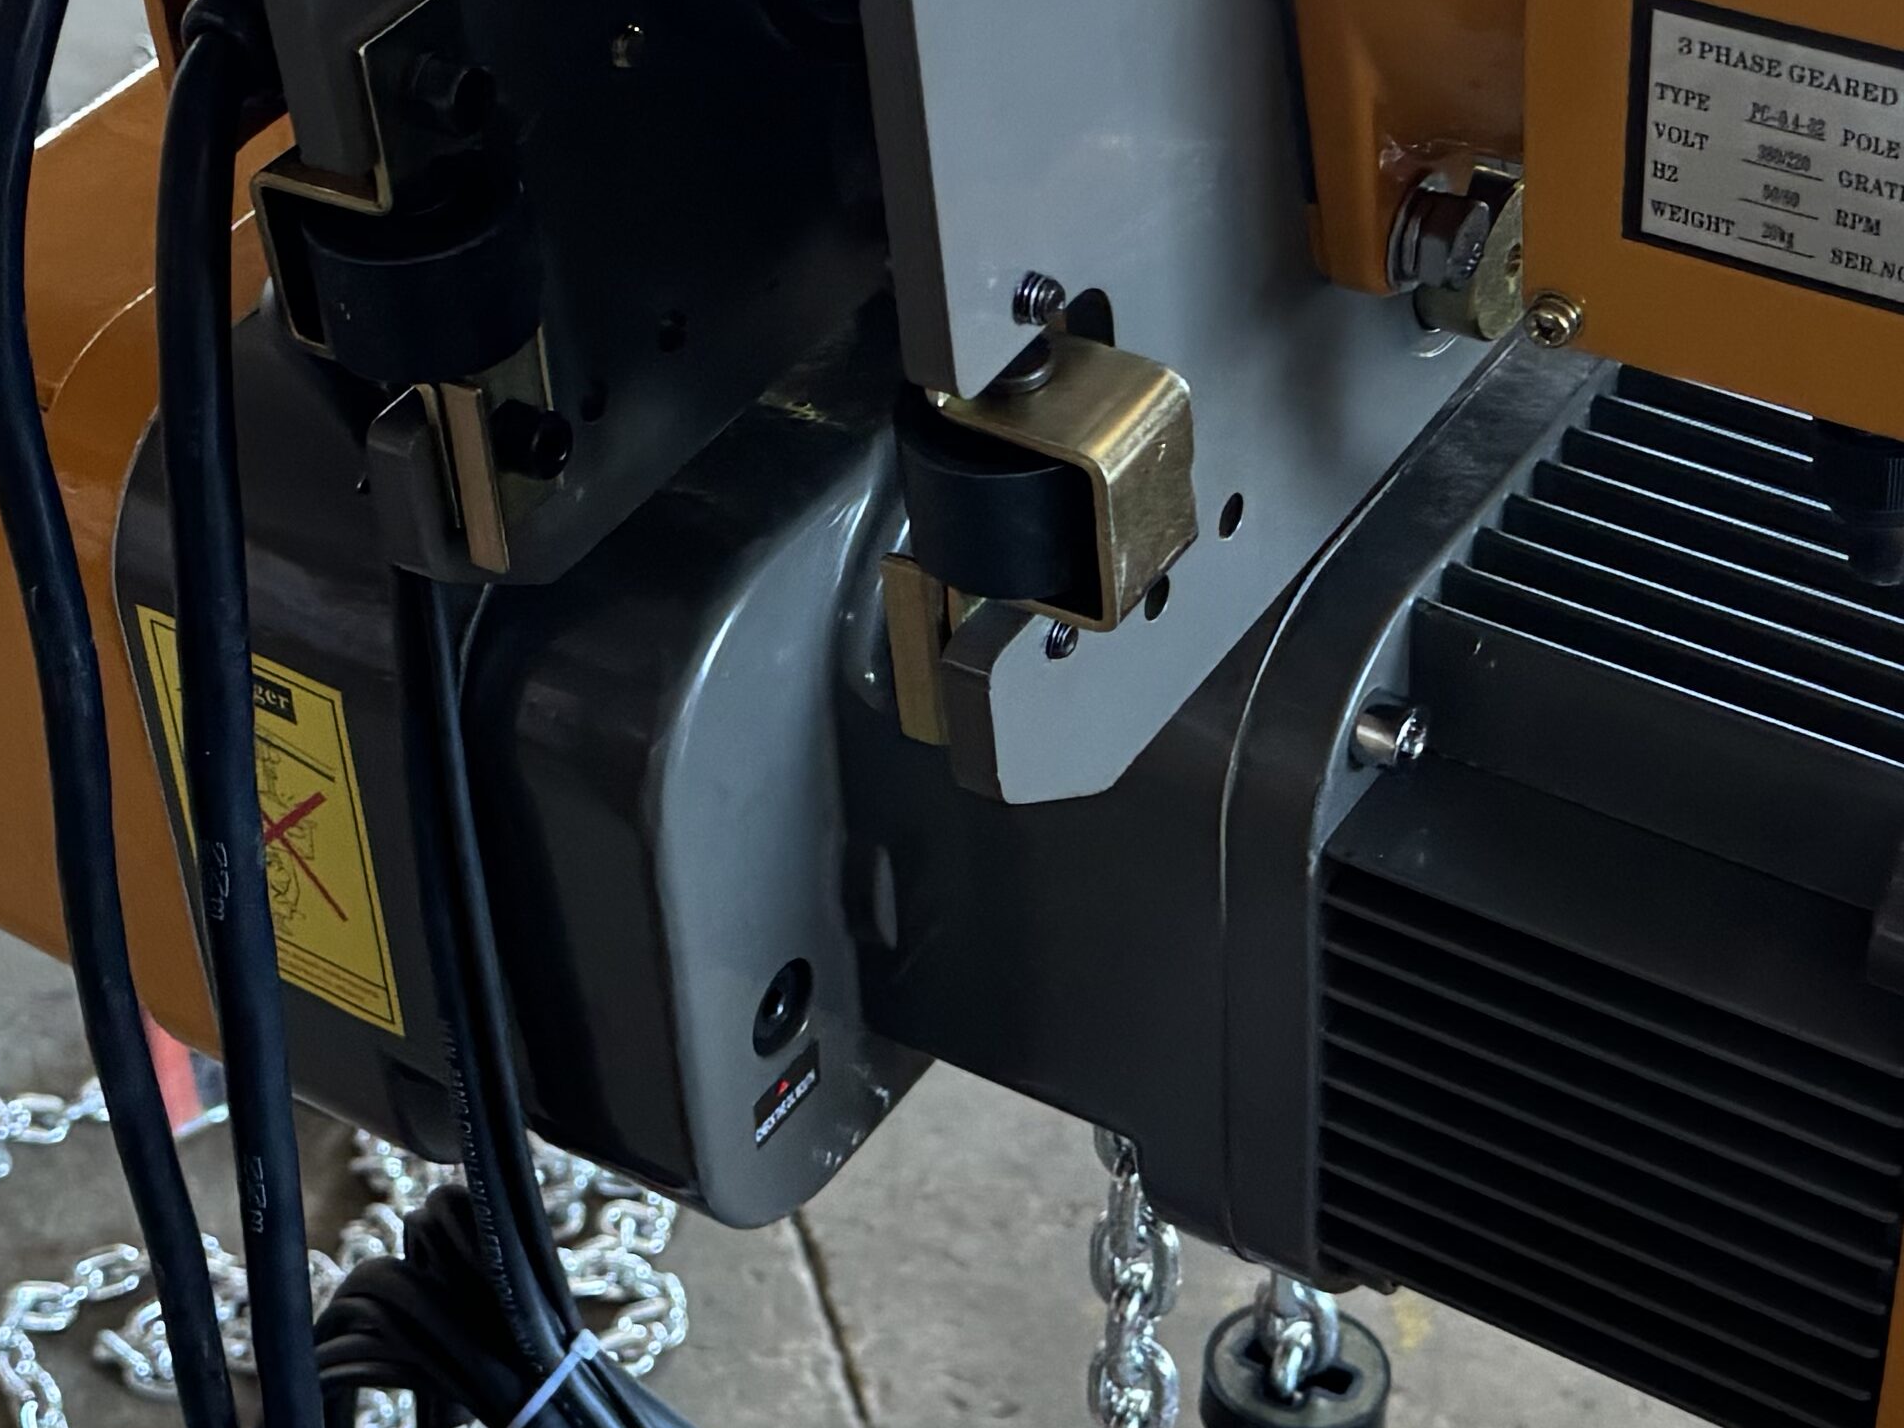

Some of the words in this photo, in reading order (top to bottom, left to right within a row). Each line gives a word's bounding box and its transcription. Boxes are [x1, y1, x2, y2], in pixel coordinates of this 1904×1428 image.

[1678, 37, 1692, 55] 3
[1698, 41, 1782, 78] PHASE
[1789, 64, 1898, 106] GEARED
[1655, 82, 1711, 112] TYPE
[1653, 123, 1709, 150] VOLT
[1840, 129, 1901, 159] POLE
[1652, 160, 1679, 183] HZ
[1650, 199, 1736, 236] WEIGHT
[1835, 209, 1881, 236] RPM
[254, 683, 290, 710] ger
